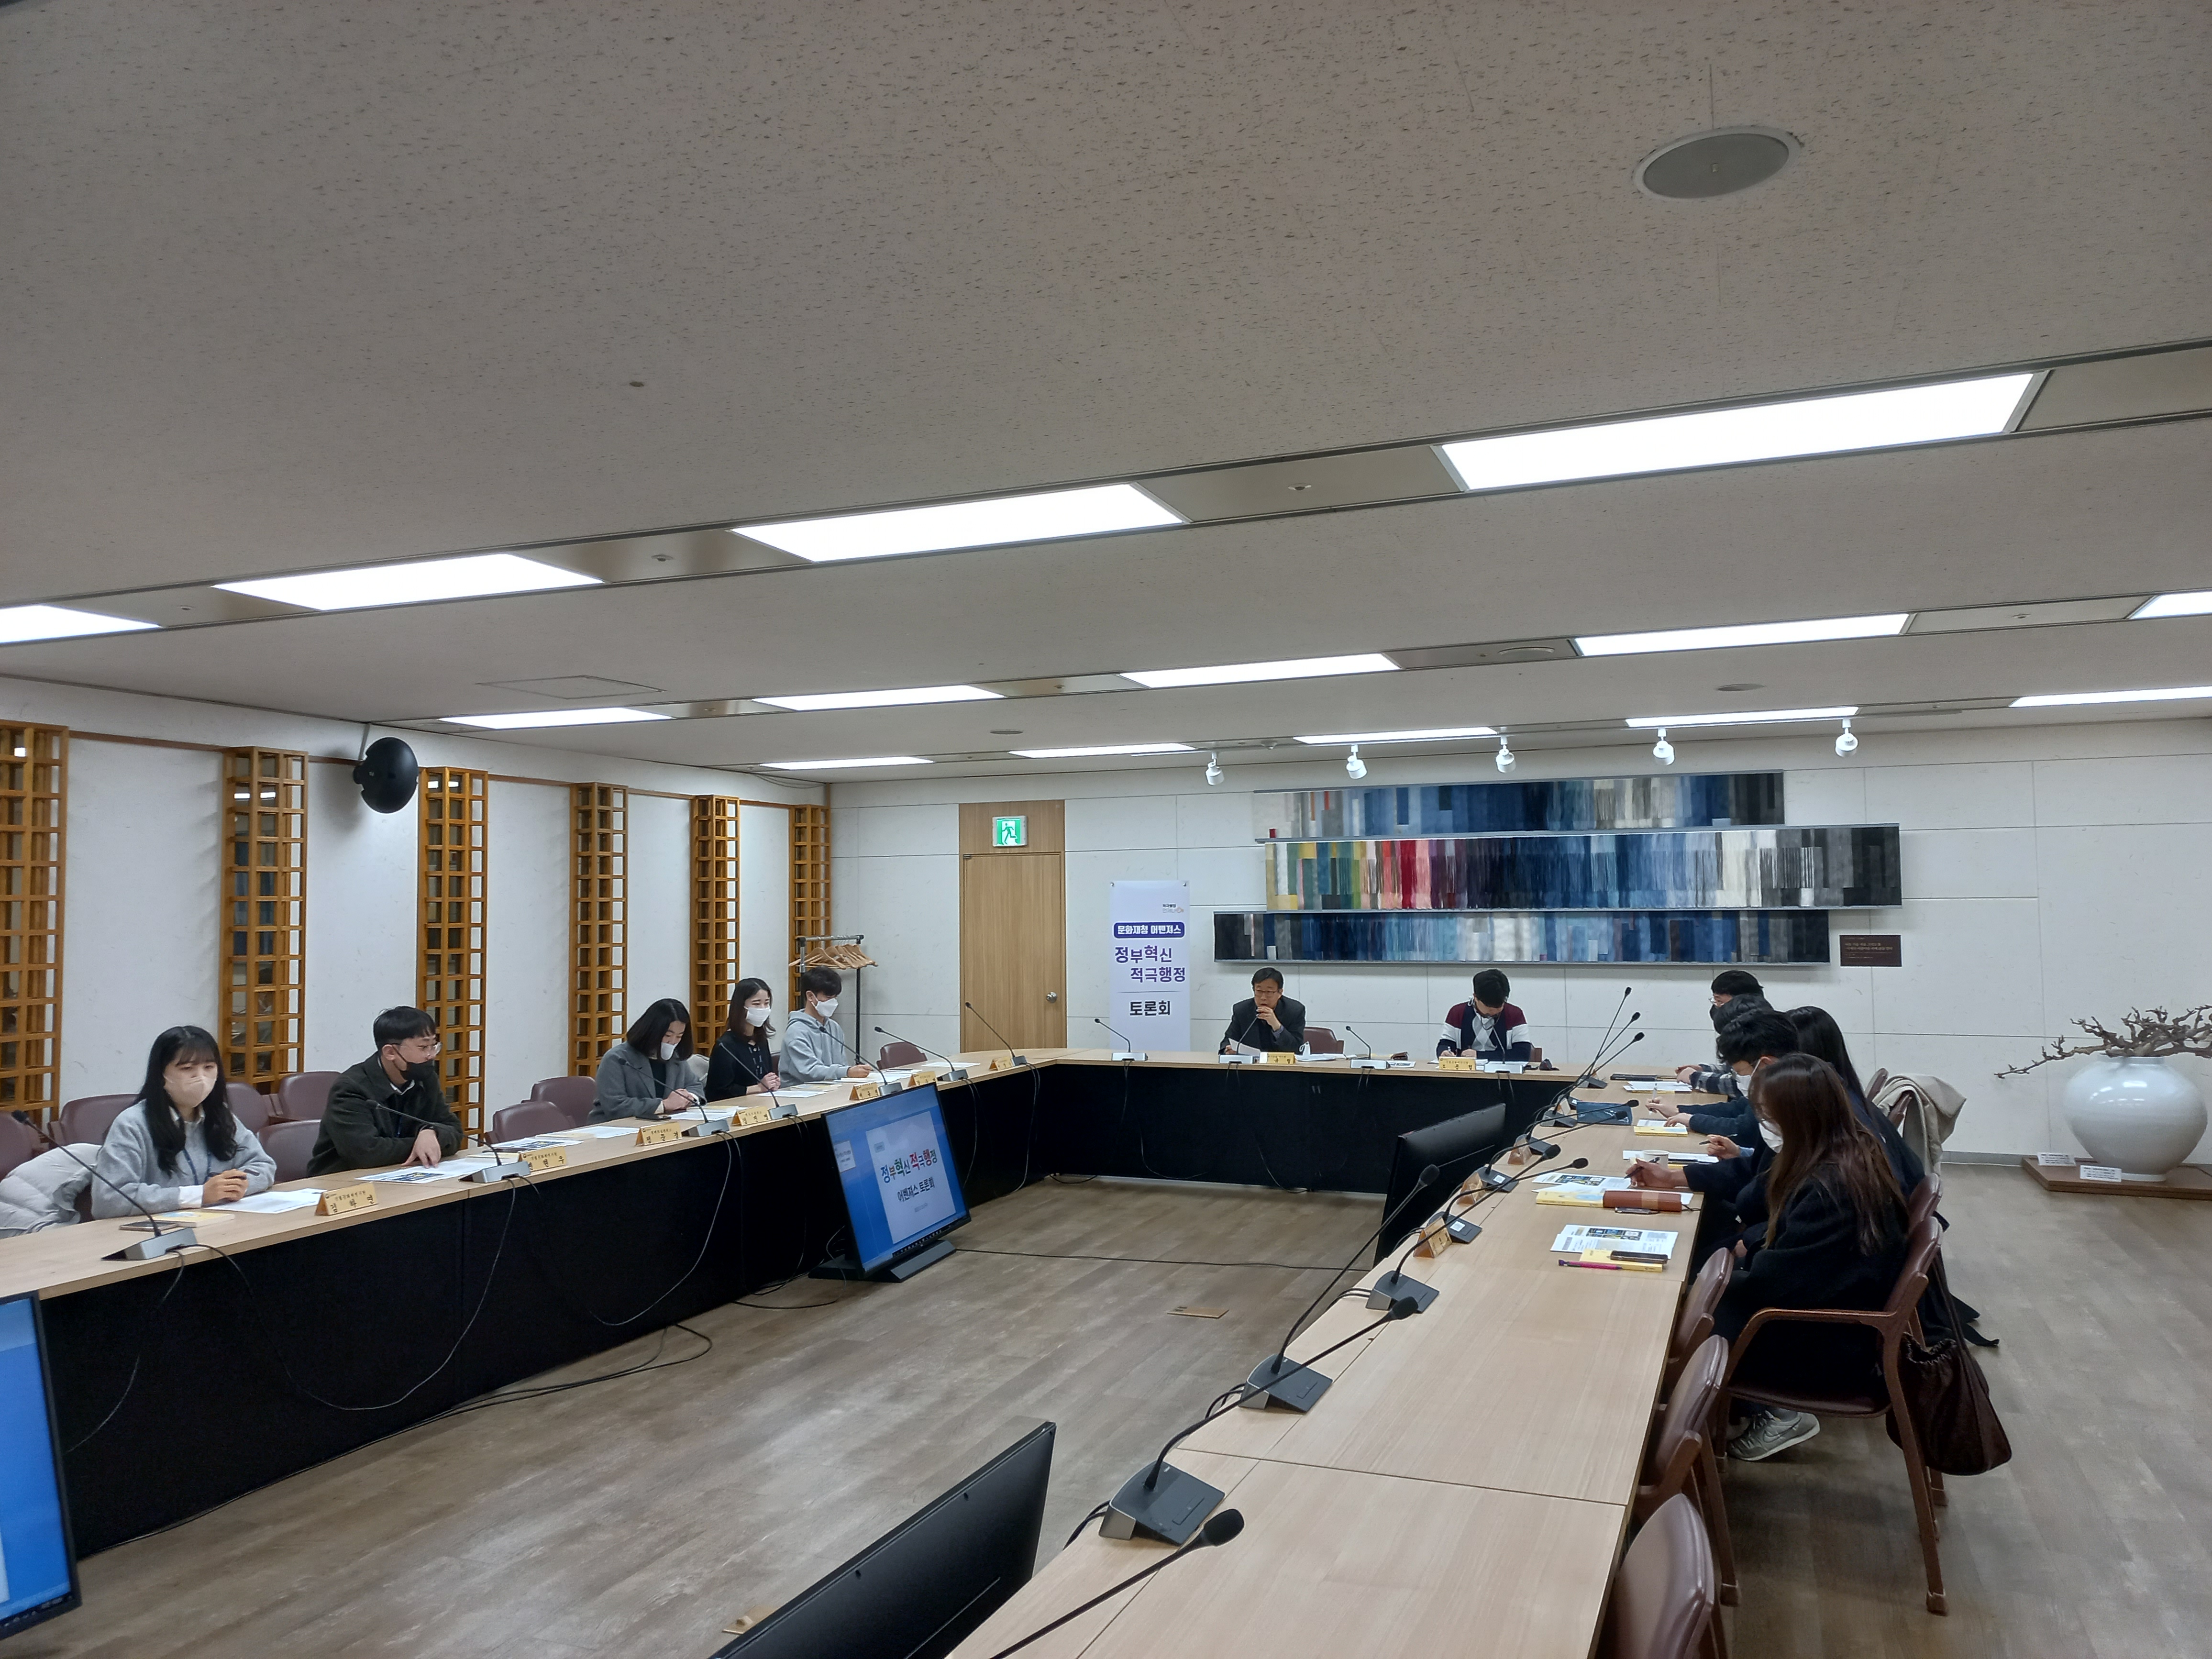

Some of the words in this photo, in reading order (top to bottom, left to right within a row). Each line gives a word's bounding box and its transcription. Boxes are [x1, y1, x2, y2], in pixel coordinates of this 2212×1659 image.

[1117, 925, 1148, 934] 문화재청
[1150, 925, 1181, 934] 어벤져스
[1115, 945, 1172, 963] 정부혁신
[1130, 967, 1186, 983] 적극행정
[1129, 1000, 1171, 1016] 토론회
[918, 1176, 935, 1192] 토론회
